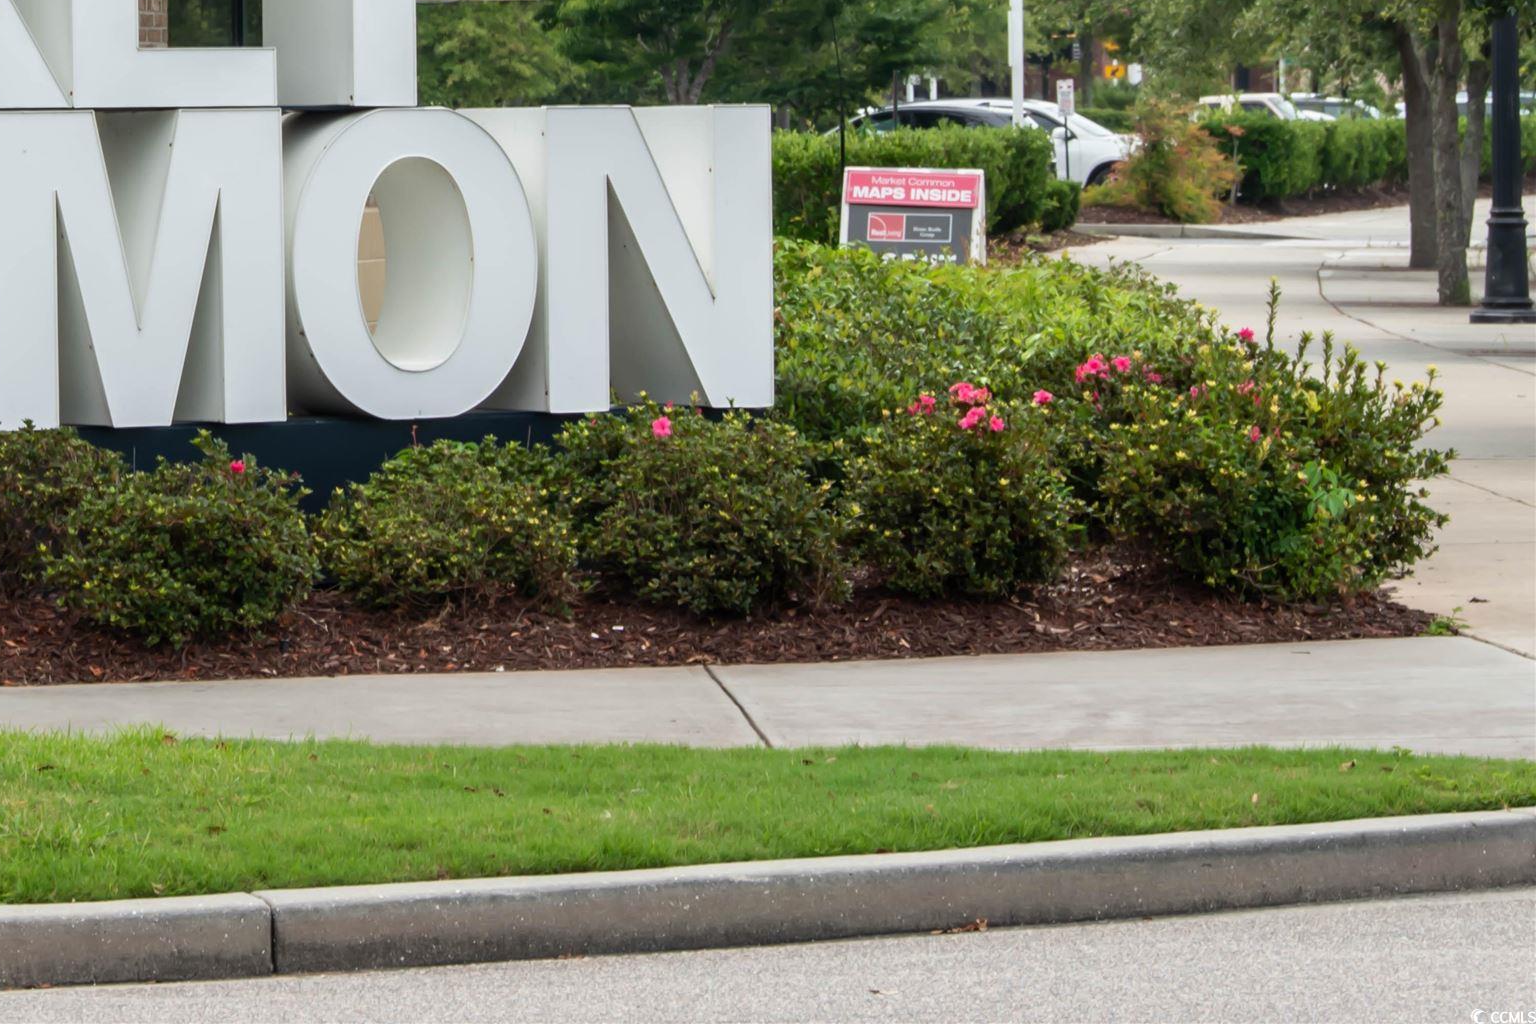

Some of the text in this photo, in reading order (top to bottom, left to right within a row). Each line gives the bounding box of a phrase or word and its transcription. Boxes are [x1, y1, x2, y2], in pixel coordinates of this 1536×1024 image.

[871, 175, 955, 188] Market Common
[852, 185, 972, 203] MAPS INSIDE
